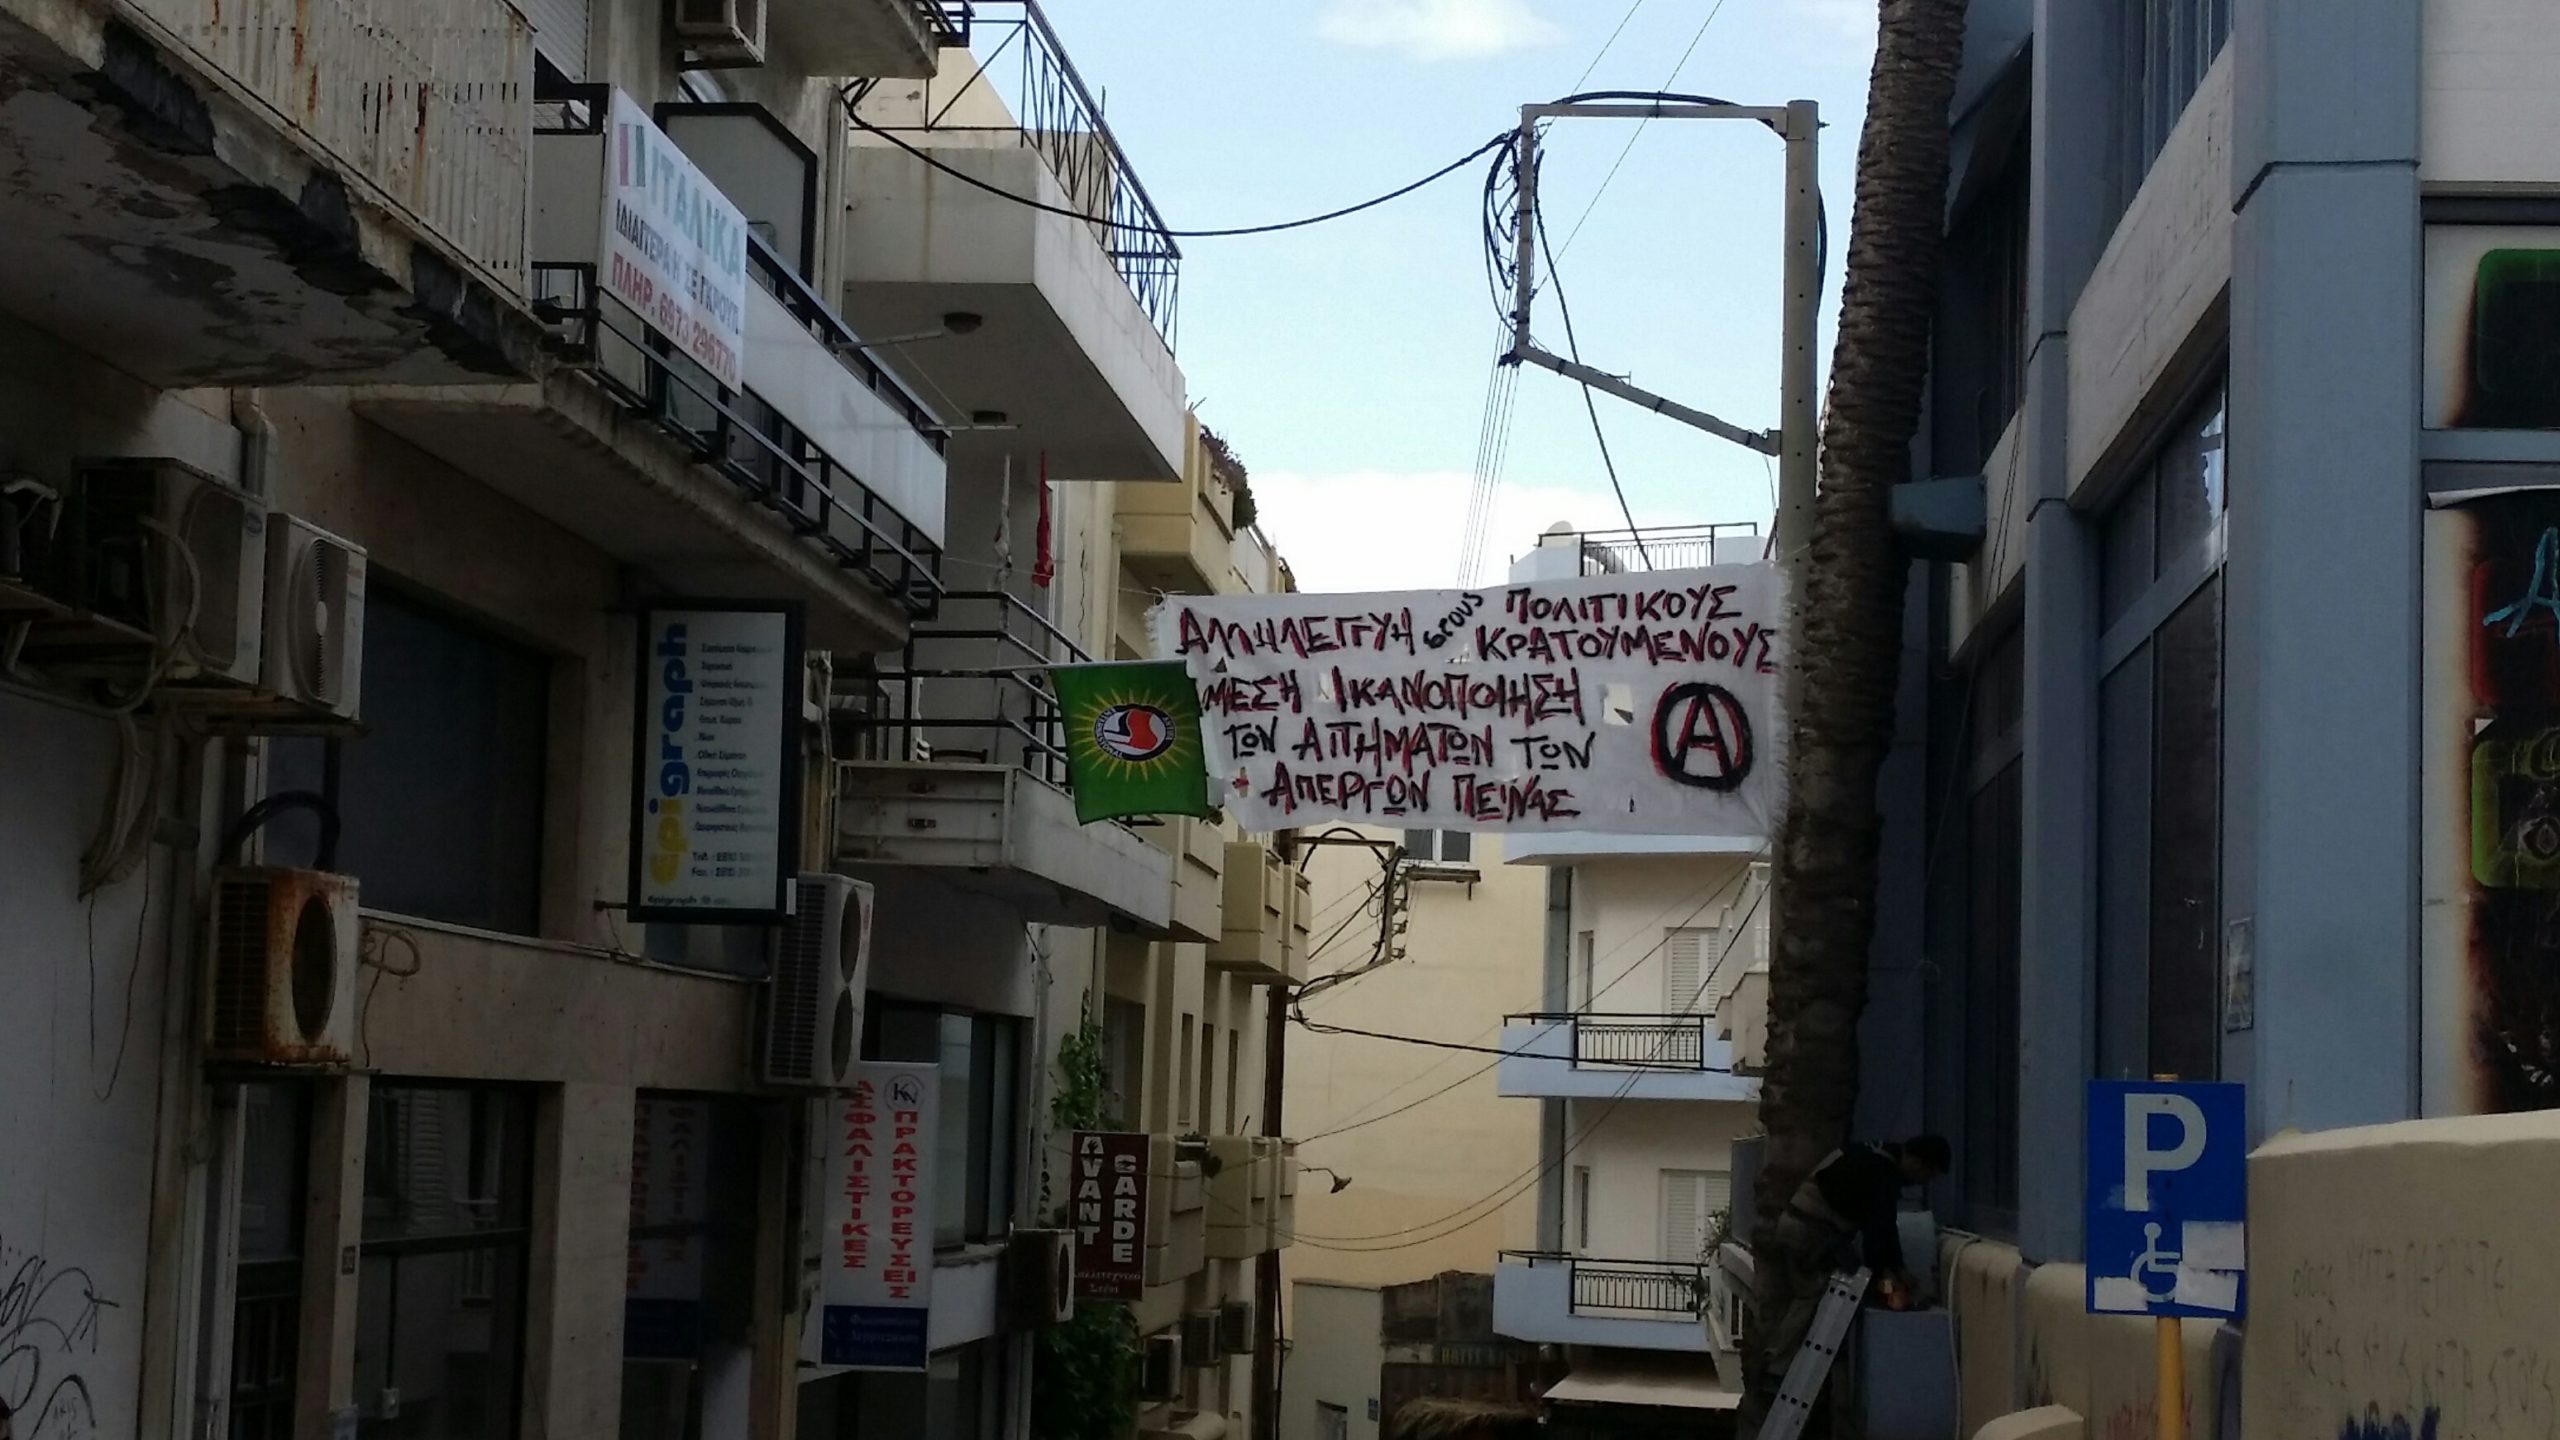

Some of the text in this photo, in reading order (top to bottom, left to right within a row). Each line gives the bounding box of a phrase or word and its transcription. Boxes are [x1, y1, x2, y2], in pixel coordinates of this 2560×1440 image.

[651, 146, 741, 285] ΙΤΑΛΙΚΑ
[612, 252, 655, 318] ΠΛΗΡ.
[1505, 583, 1742, 625] ΠΟΛΙΤΙΚΟΥΣ
[1175, 606, 1416, 660] ΑΛΛΗΛΕΓΓΥΗ
[1476, 621, 1781, 674] ΚΡΑΤΟΥΜΕΝΟΥΣ
[1202, 664, 1586, 728] ΜΕΣΗ ΙΚΑΝΟΠΟΙΗΣΗ
[648, 622, 694, 888] epigraph
[1291, 716, 1494, 778] ΑΙΤΗΜΑΤΩΝ
[1261, 760, 1582, 823] ΑΠΕΡΓΩΝ ΠΕΙΝΑΣ
[2124, 1093, 2207, 1211] P
[883, 1110, 919, 1299] ΠΡΑΚΤΟΡΕΥΣΕΙΣ
[1077, 1136, 1104, 1246] AVANT
